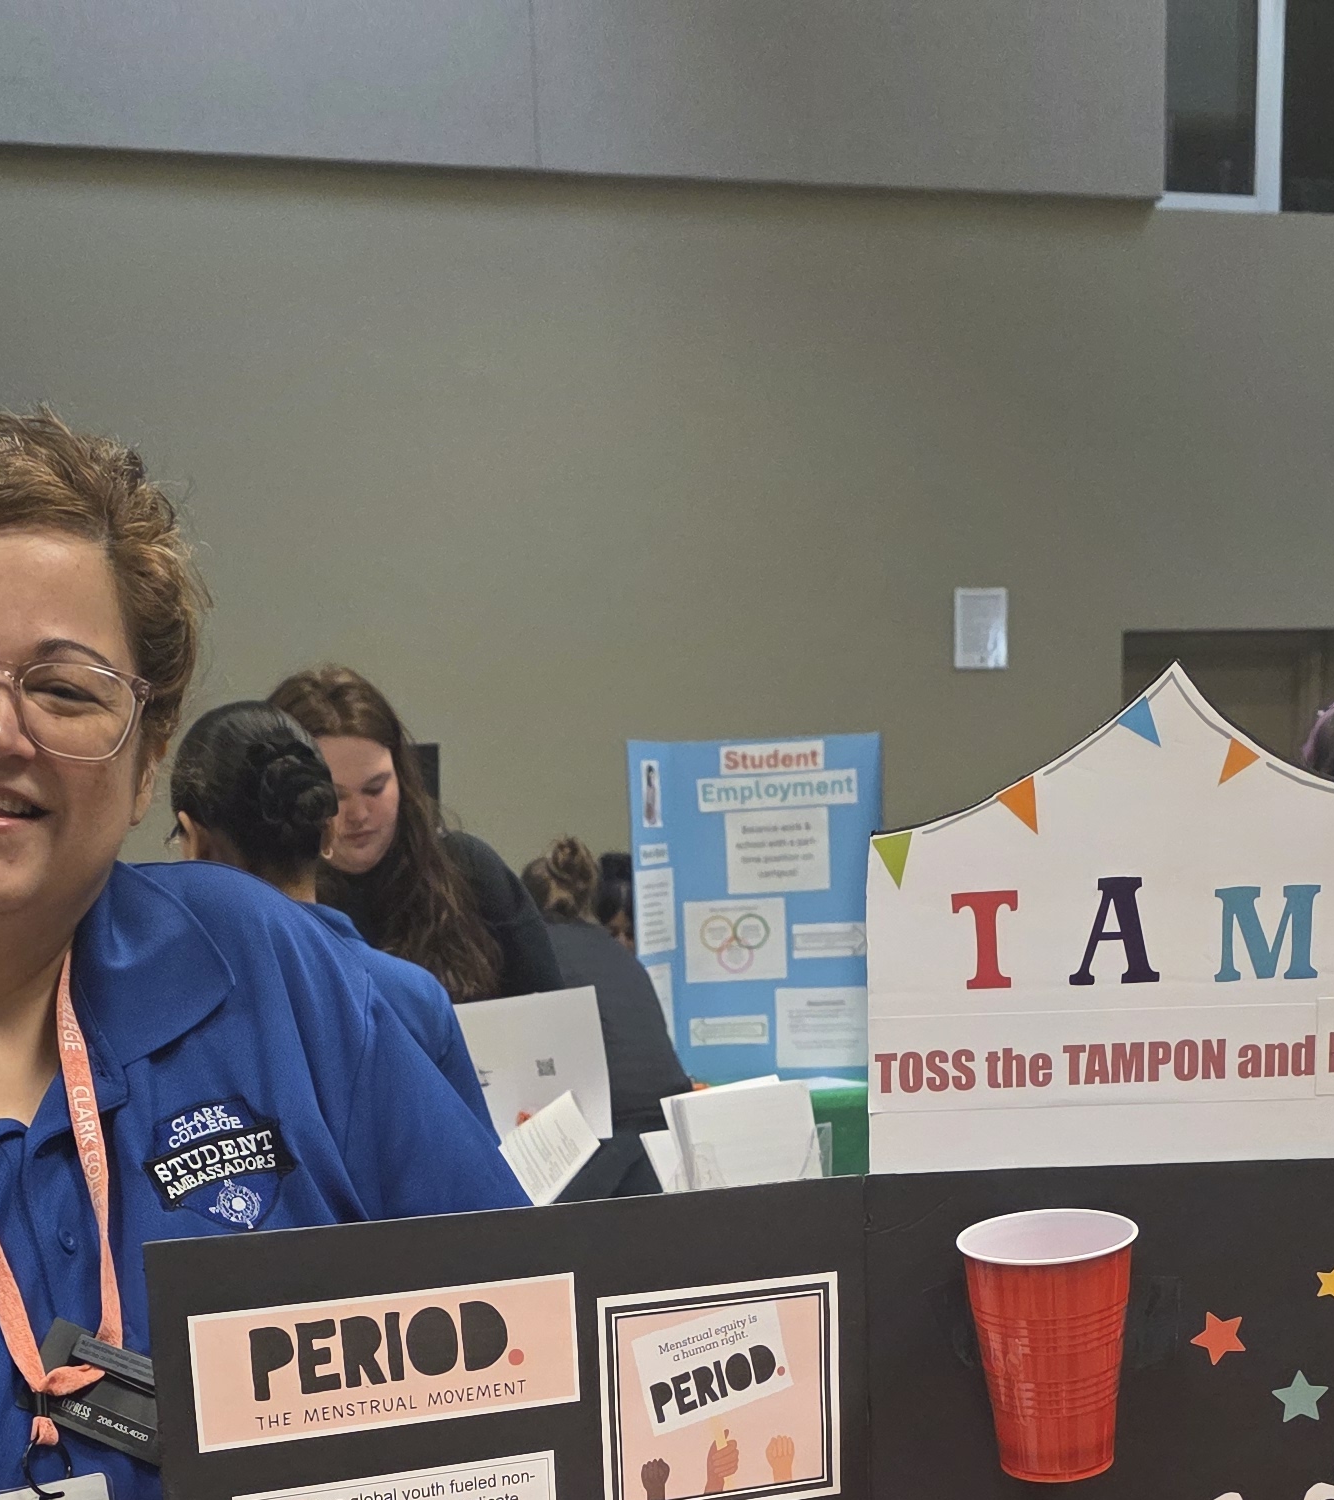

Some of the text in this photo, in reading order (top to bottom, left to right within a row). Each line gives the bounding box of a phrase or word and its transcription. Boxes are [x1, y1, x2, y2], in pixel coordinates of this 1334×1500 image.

[724, 750, 818, 770] Student
[701, 775, 853, 805] Employment
[875, 1049, 975, 1094] TOSS
[986, 1047, 1053, 1090] the
[1063, 1039, 1226, 1087] TAMPON
[1237, 1035, 1316, 1080] and
[72, 1085, 99, 1148] CLARK
[168, 1117, 243, 1148] COLLEGE
[171, 1105, 227, 1132] CLARK
[154, 1130, 273, 1183] STUDENT
[167, 1154, 275, 1199] AMBASSADORS
[249, 1300, 524, 1401] PERIOD.
[659, 1315, 757, 1354] Menstrual equity is
[673, 1330, 749, 1362] a human right.
[256, 1380, 527, 1430] THE MENSTRUAL MOVEMENT
[649, 1344, 785, 1424] PERIOD.
[449, 1474, 496, 1497] fueled
[501, 1472, 535, 1486] non-
